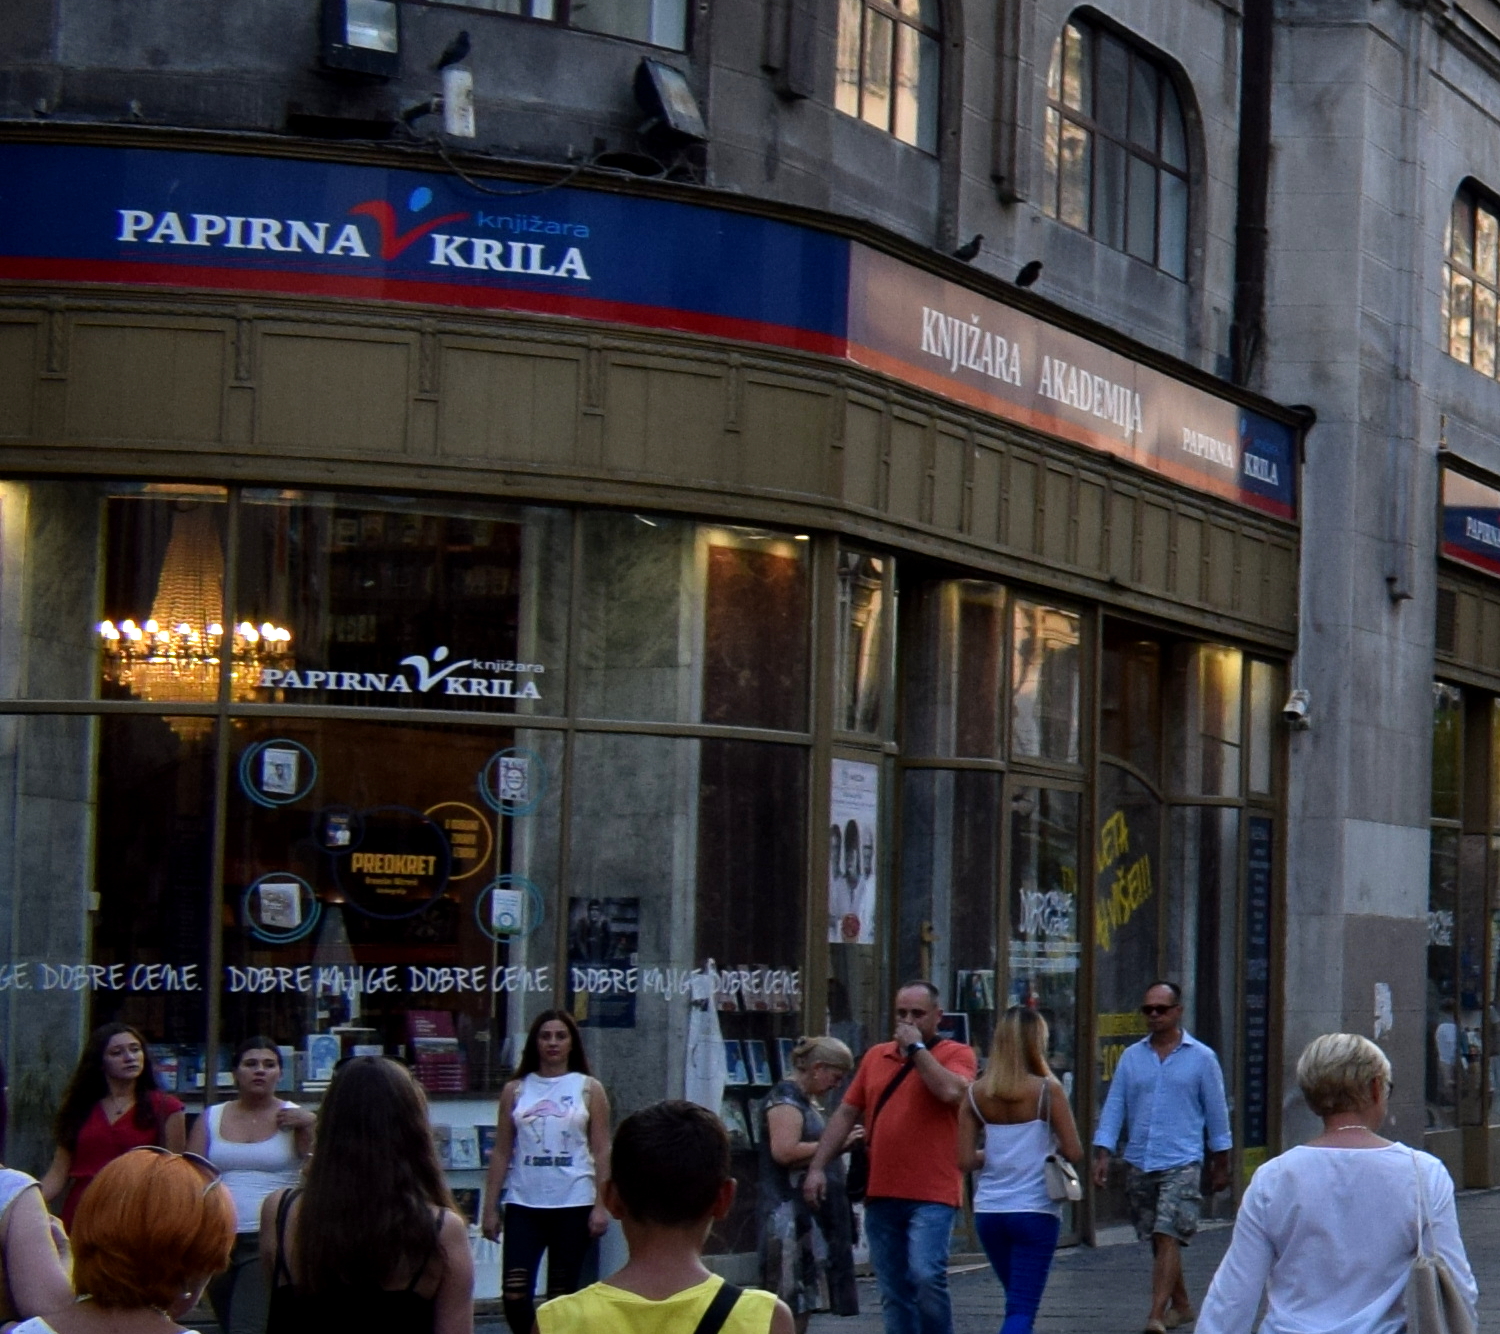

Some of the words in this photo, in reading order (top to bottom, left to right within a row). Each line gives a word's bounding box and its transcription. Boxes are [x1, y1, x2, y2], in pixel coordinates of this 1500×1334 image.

[478, 211, 591, 239] knjižara
[116, 209, 371, 258] PAPIRNA
[429, 233, 592, 281] KRILA
[920, 306, 1022, 387] KNJIŽARA
[1037, 354, 1144, 439] AKADEMIJA
[1181, 426, 1235, 469] PAPIRNA
[1244, 452, 1280, 487] KRILA
[472, 658, 546, 674] knjižara
[261, 668, 413, 693] PAPIRNA
[445, 676, 543, 699] KRILA
[41, 963, 126, 993] DOBRE
[131, 963, 202, 993] CENE.
[229, 965, 311, 994] DOBRE
[410, 965, 487, 994] DOBRE
[571, 967, 638, 995] DOBRE
